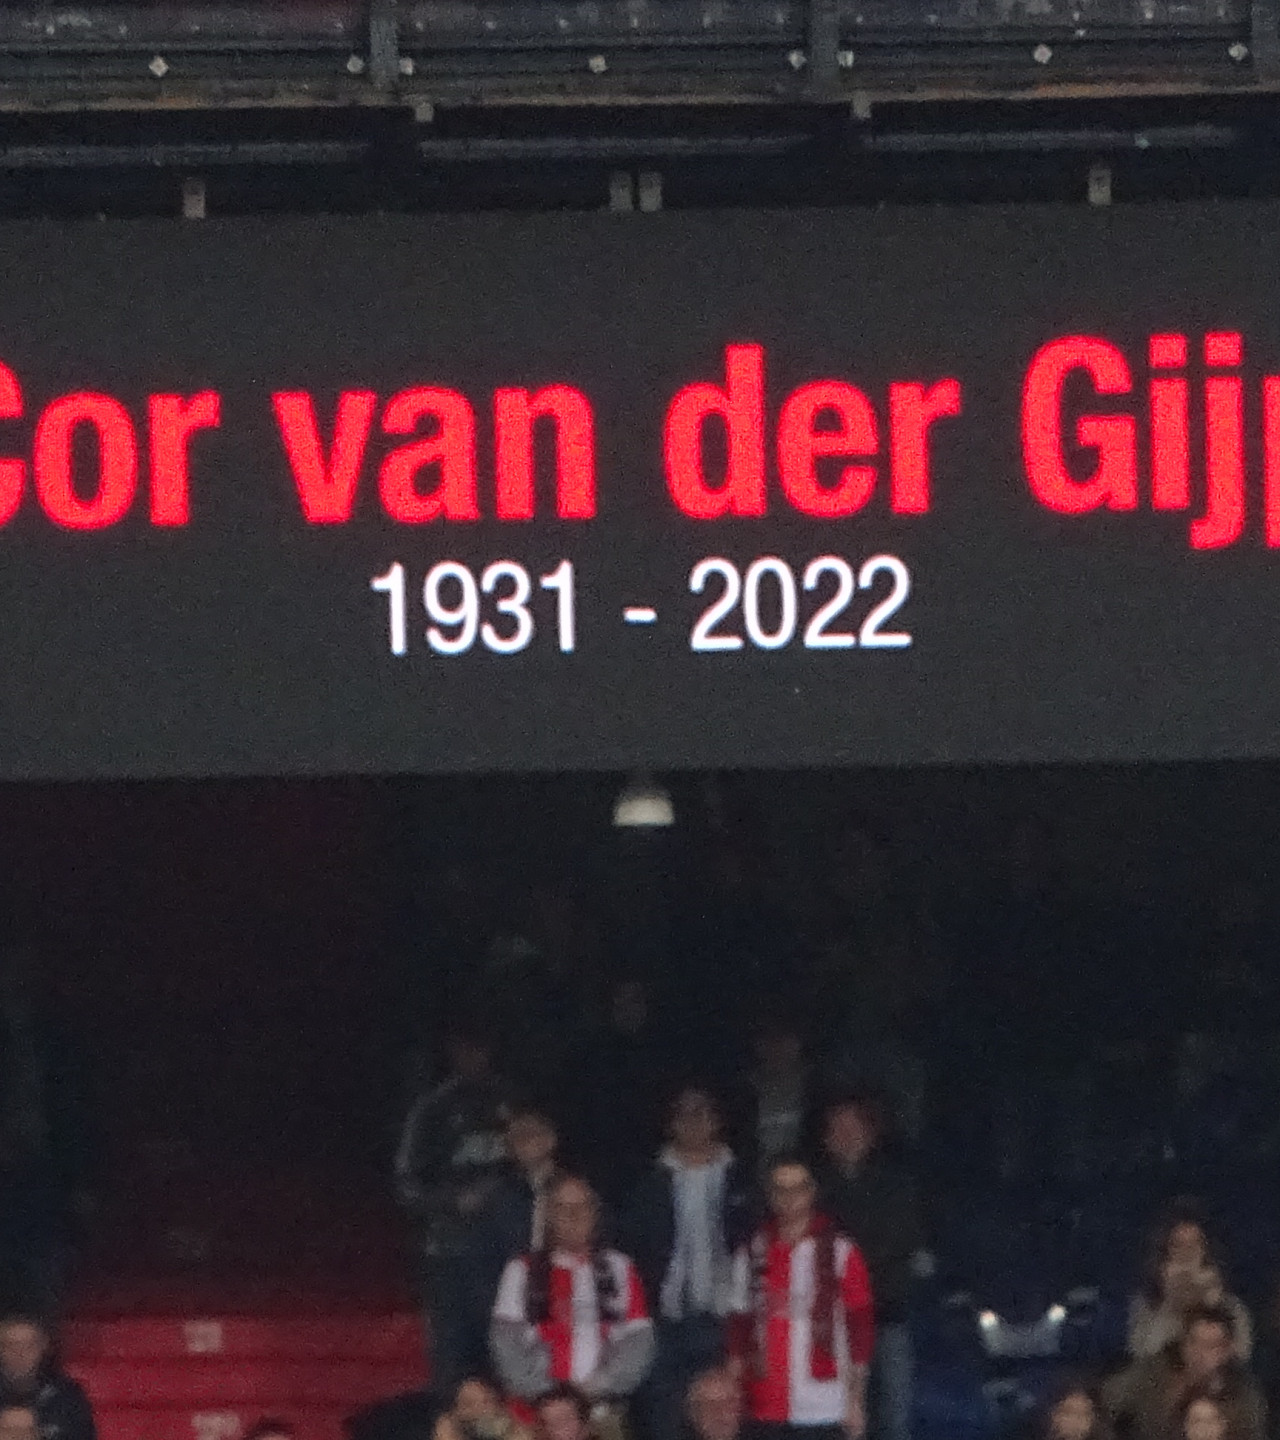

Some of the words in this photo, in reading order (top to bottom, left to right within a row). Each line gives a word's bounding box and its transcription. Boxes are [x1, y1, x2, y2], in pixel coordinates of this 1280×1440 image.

[271, 384, 597, 524] van
[662, 342, 962, 521] der
[370, 559, 577, 656] 1931
[623, 605, 659, 625] -
[688, 554, 913, 651] 2022
